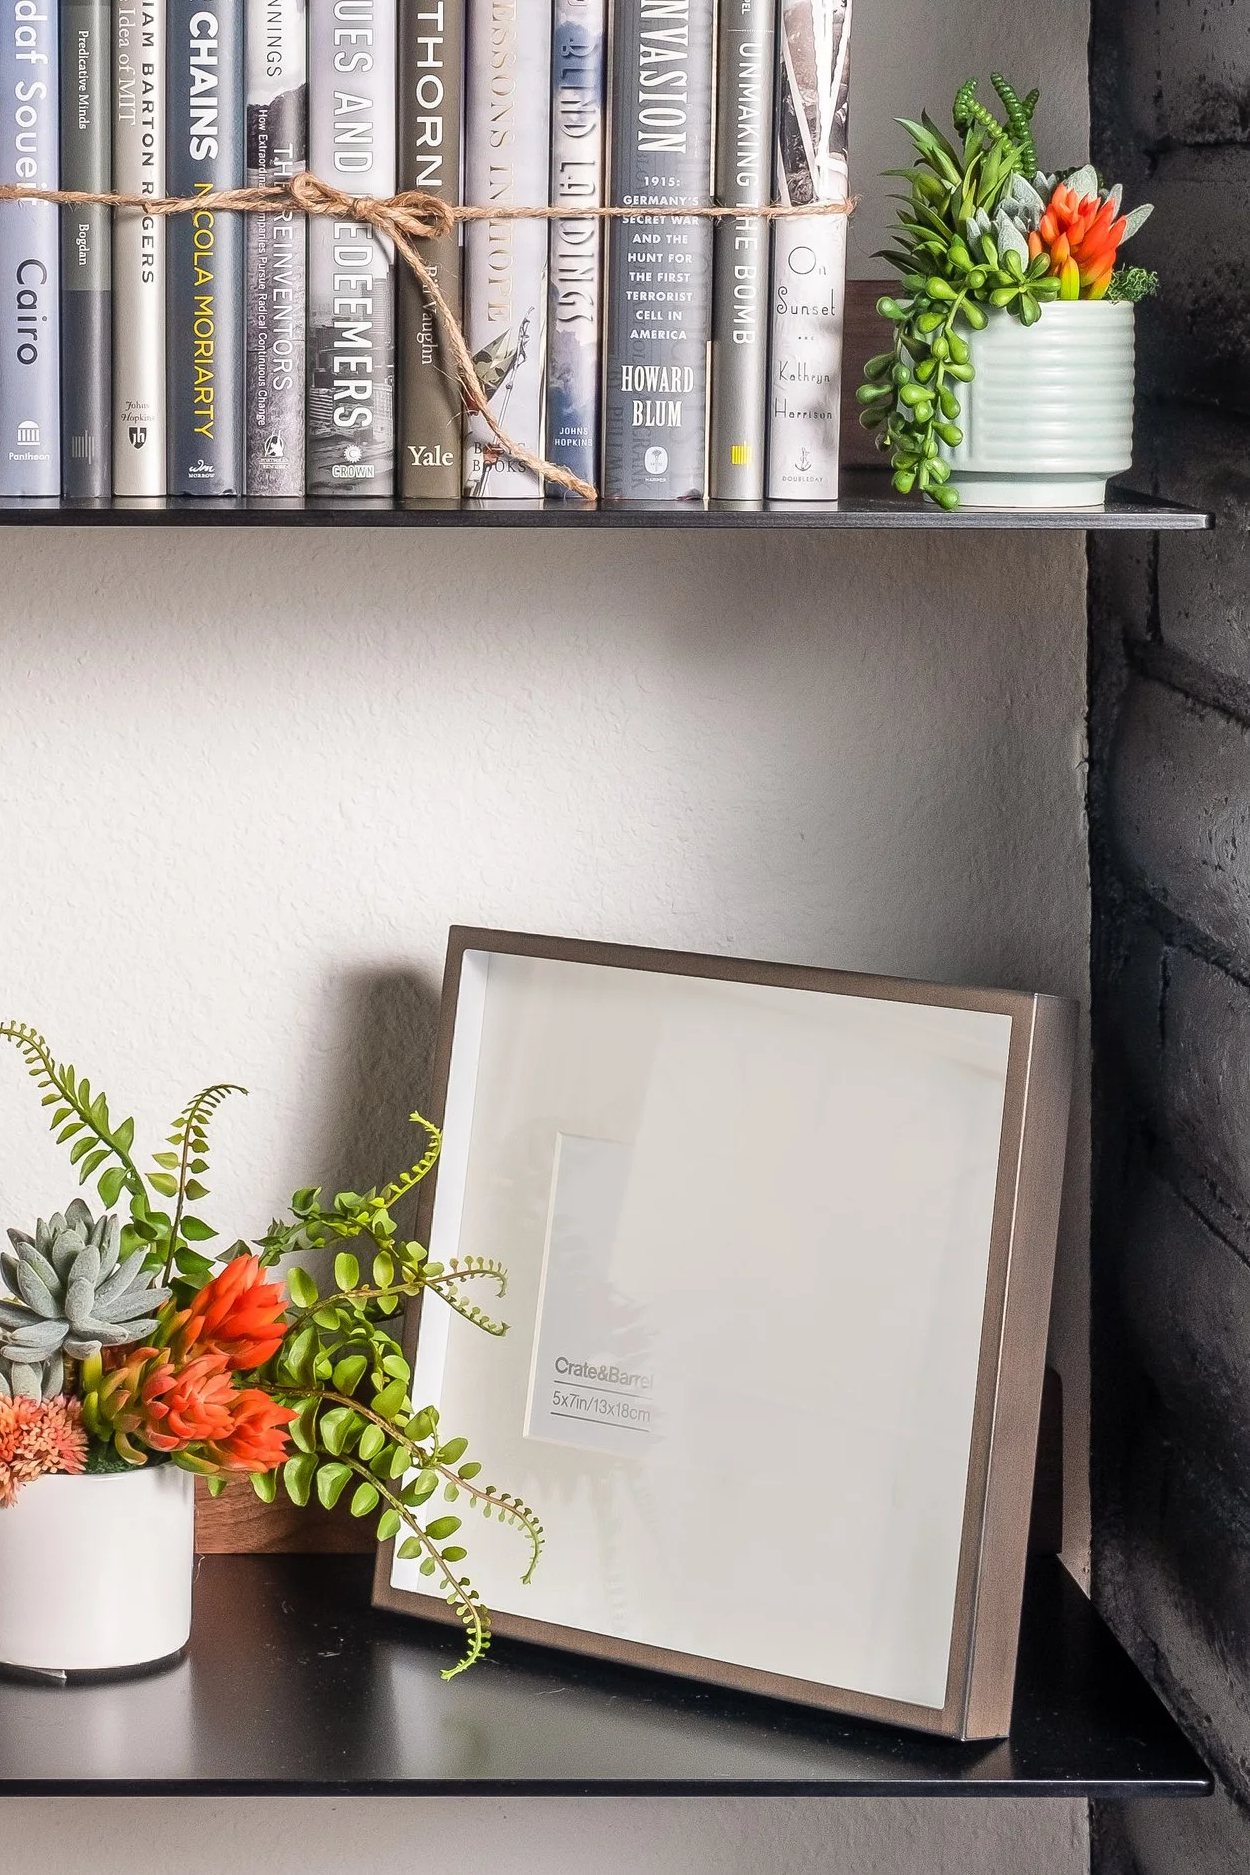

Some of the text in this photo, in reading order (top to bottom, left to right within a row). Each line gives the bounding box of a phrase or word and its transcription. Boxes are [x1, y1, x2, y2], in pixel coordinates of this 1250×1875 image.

[118, 7, 135, 48] Idea
[76, 30, 89, 130] Predicative Minds
[118, 54, 136, 75] of
[117, 77, 135, 126] MIT
[190, 11, 218, 161] CHAINS
[560, 38, 597, 138] BLIND
[141, 62, 154, 167] BARTON
[333, 90, 373, 174] AND
[489, 162, 513, 202] IN
[643, 176, 681, 187] 1915:
[731, 41, 762, 345] UNMAKING THE BOMB
[141, 180, 154, 284] RGERS
[622, 215, 698, 225] SECRET WAR
[74, 223, 90, 266] Bogdan
[632, 233, 688, 244] AND THE
[256, 108, 269, 426] How Extraordina mpanies Pursue Radical Continuous Change
[487, 220, 512, 323] HOPE
[627, 253, 692, 264] HUNT FOR
[787, 245, 827, 276] On
[629, 272, 690, 283] THE FIRST
[16, 257, 48, 365] Cairo
[193, 182, 214, 440] NCOLA MORIARTY
[272, 209, 292, 391] REINVENTORS
[626, 291, 692, 302] TERRORIST
[776, 285, 835, 317] Sunset
[333, 217, 373, 427] EDEEMERS
[635, 310, 681, 321] CELL IN
[416, 300, 438, 365] Vaughn
[629, 329, 687, 340] AMERICA
[621, 364, 693, 393] HOWARD
[778, 360, 830, 384] Kathryn
[125, 400, 150, 412] Johns
[632, 400, 681, 428] BLUM
[773, 399, 832, 421] Harrison
[554, 438, 593, 448] HOPKINS
[559, 427, 588, 436] JOHNS
[8, 451, 50, 461] Pantheon
[332, 464, 374, 478] CROWN
[407, 445, 453, 467] Yale
[781, 475, 823, 483] DOUBLEDAY
[555, 1357, 653, 1389] Crate&Barrel
[553, 1391, 650, 1422] 5x7in/13x18cm
